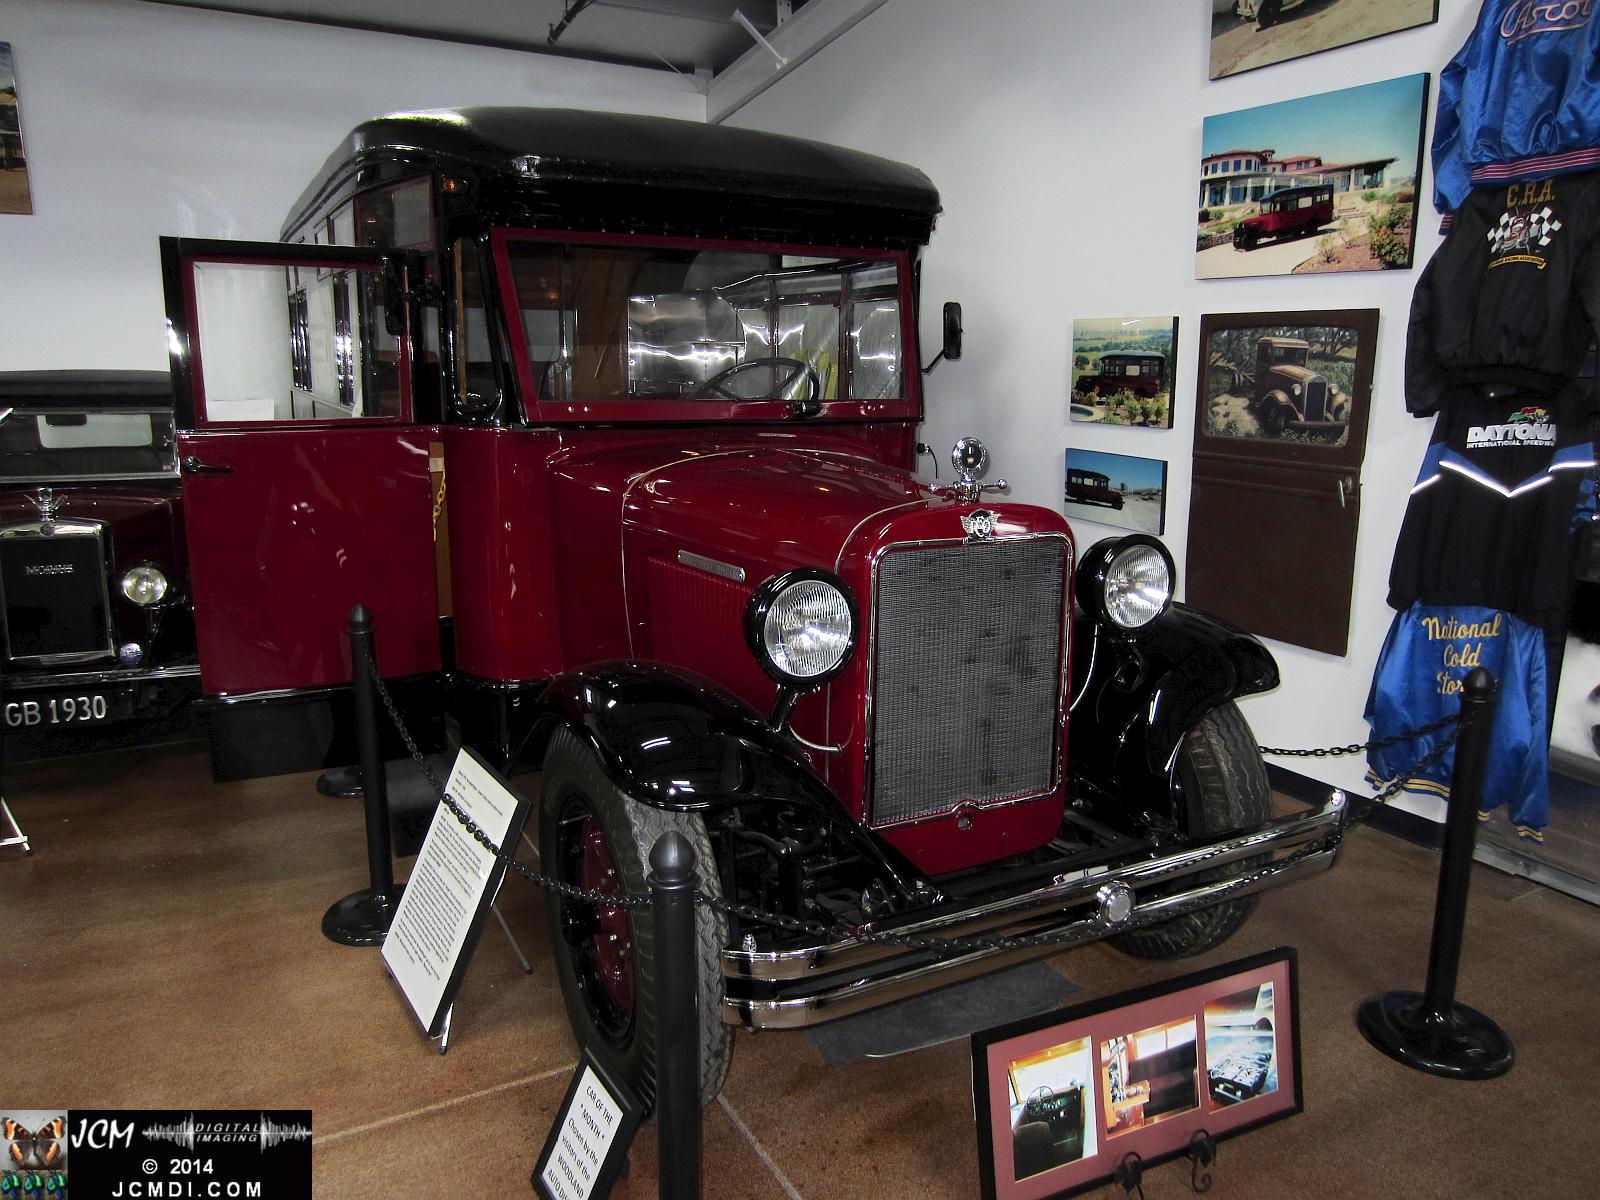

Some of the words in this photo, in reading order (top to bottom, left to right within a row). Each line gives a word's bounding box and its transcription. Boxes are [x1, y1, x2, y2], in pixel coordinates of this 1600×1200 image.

[1466, 423, 1556, 442] DAYTONA
[1466, 440, 1521, 449] INTERNATIONAL
[1421, 613, 1502, 641] National
[1443, 642, 1483, 668] Cold
[5, 701, 41, 727] GB
[50, 695, 107, 724] 1930
[586, 1086, 597, 1104] CAR
[595, 1099, 604, 1111] OF
[602, 1107, 614, 1127] THE
[568, 1117, 584, 1145] Chosen
[583, 1140, 591, 1155] by
[589, 1150, 599, 1166] the
[562, 1135, 578, 1162] visitors
[576, 1160, 584, 1170] of
[581, 1166, 591, 1182] the
[547, 1169, 561, 1192] AUTO
[557, 1153, 584, 1199] WOODLAND
